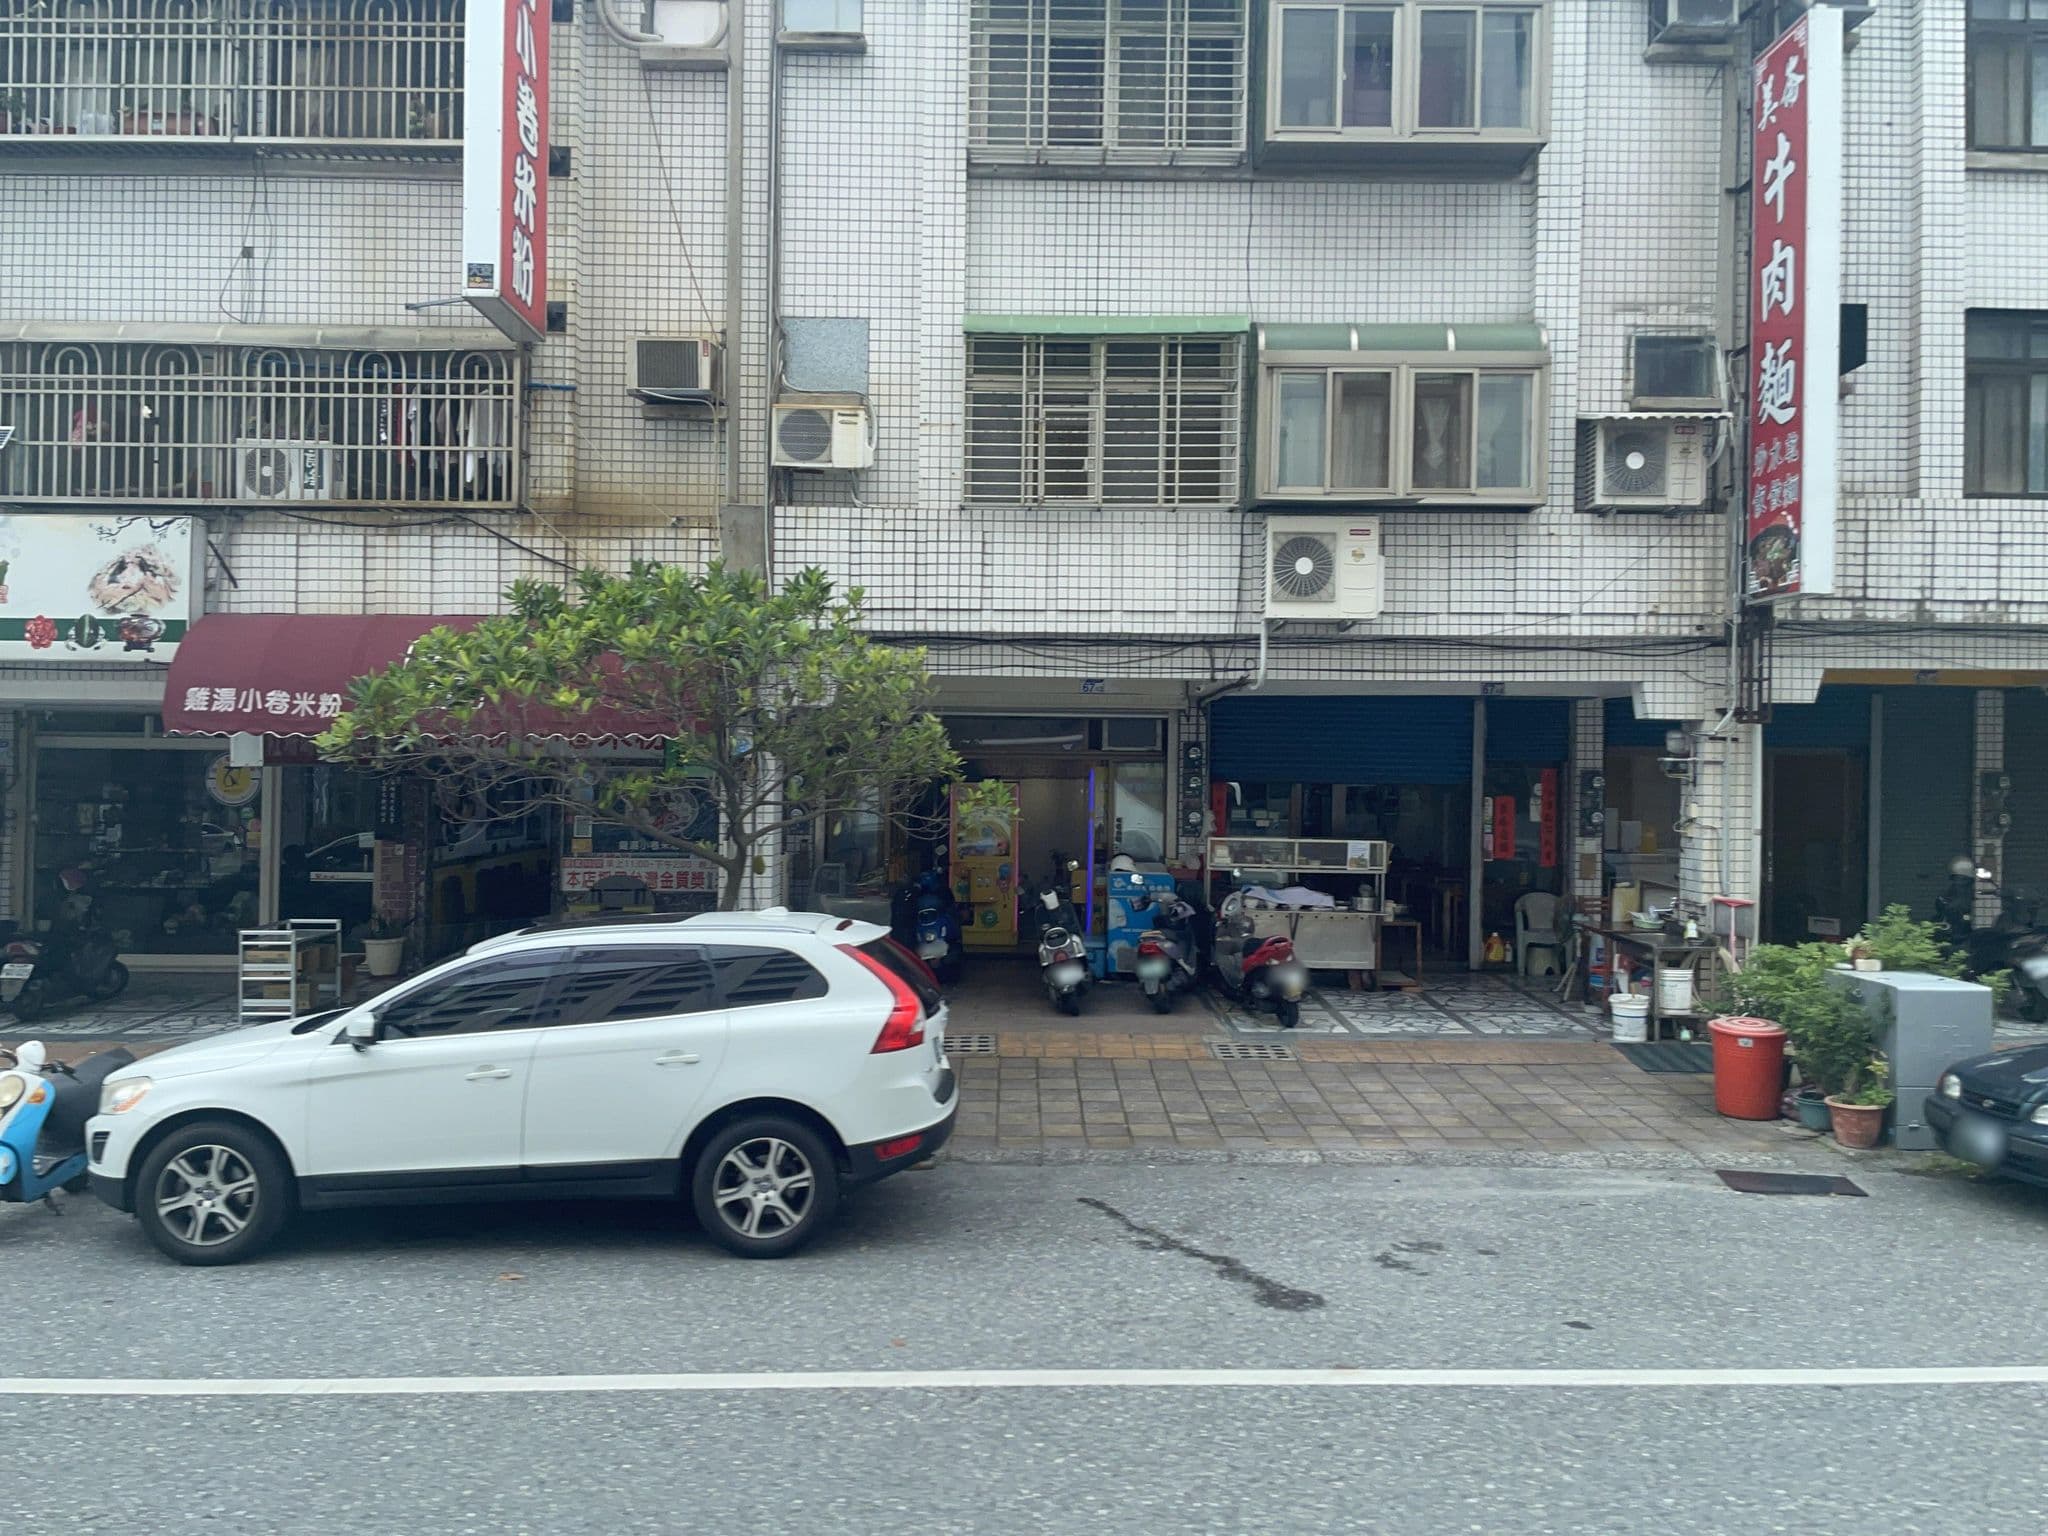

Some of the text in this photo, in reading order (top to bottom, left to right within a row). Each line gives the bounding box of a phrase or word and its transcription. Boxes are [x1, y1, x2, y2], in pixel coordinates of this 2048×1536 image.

[512, 0, 539, 307] 小卷米粉
[1757, 132, 1798, 427] 牛肉麵
[183, 686, 343, 718] 雞湯小卷米粉
